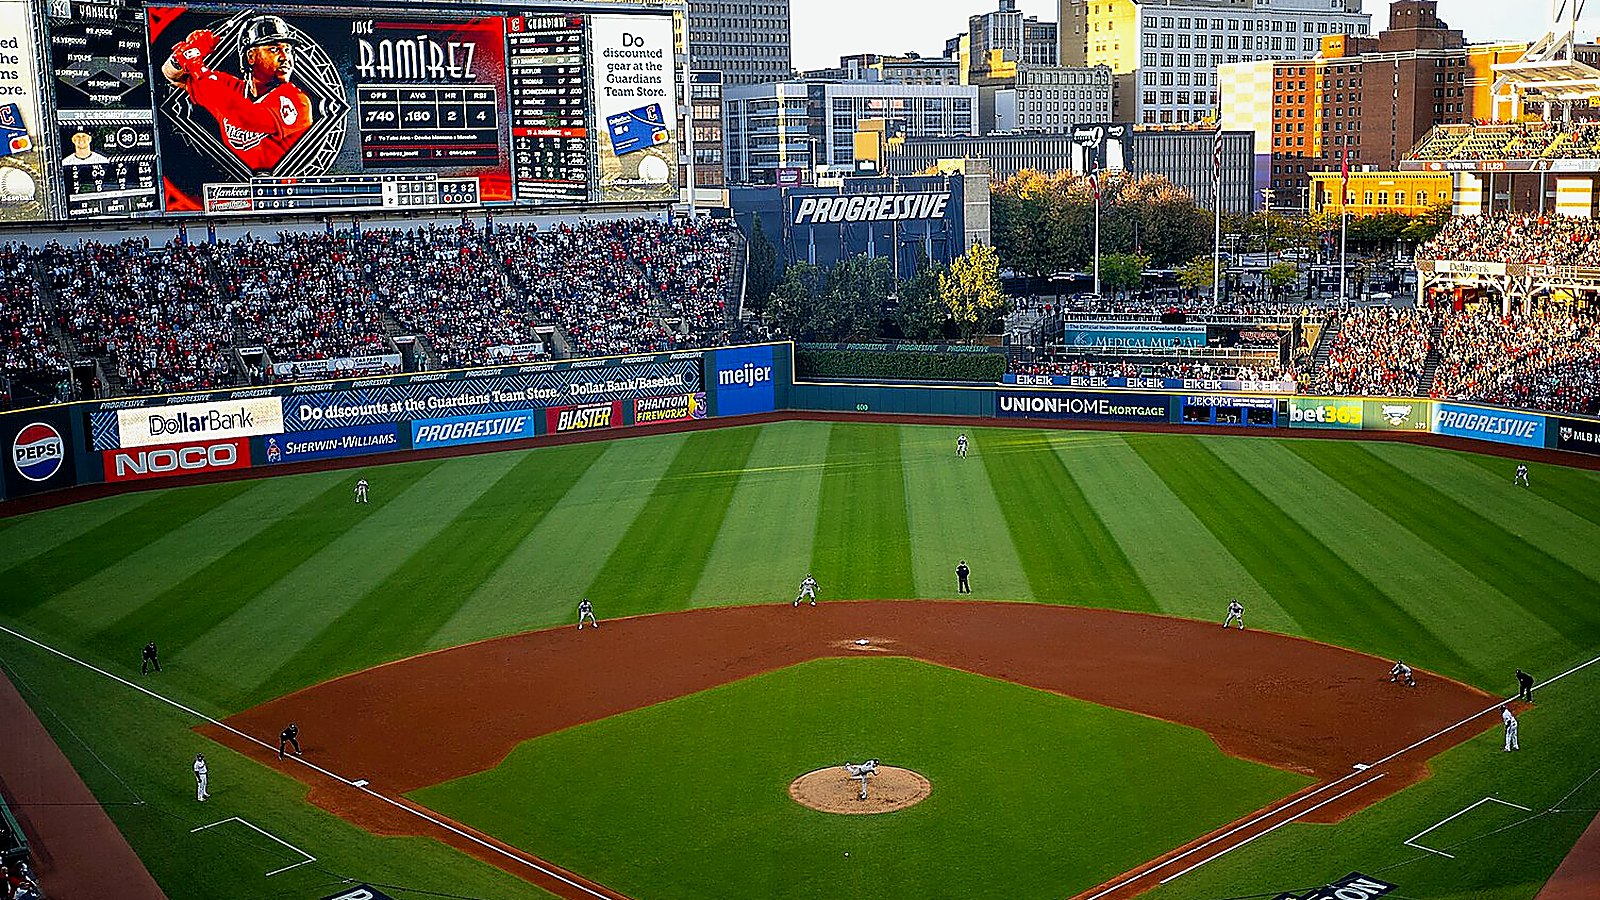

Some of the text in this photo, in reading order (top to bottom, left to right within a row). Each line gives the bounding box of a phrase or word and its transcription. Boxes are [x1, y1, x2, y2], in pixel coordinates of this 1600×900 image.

[79, 5, 118, 20] YANKEES
[528, 17, 566, 29] GUARDIANS
[0, 37, 18, 48] ed
[623, 33, 644, 47] Do
[356, 34, 477, 78] RAMÍREZ
[603, 48, 662, 58] discounted
[607, 63, 631, 72] gear
[645, 61, 662, 70] the
[607, 74, 662, 83] Guardians
[0, 86, 26, 95] ore.
[604, 87, 666, 96] Team Store.
[365, 111, 395, 122] .740
[448, 111, 457, 121] 2
[476, 111, 486, 120] 4
[211, 187, 249, 199] Yankees
[796, 194, 950, 224] PROGRESSIVE
[1096, 337, 1147, 347] MEDICAL
[718, 363, 770, 387] meijer
[293, 384, 334, 393] PROGRESSIVE
[352, 379, 392, 388] PROGRESSIVE
[167, 394, 210, 404] PROGRESSIVE
[231, 389, 274, 398] PROGRESSIVE
[100, 400, 145, 409] PROGRESSIVE
[300, 387, 560, 421] Do discounts at the Guardians Team Store.
[637, 396, 688, 410] PHANTOM
[637, 408, 688, 422] FIREWORKS
[1110, 405, 1164, 417] MORTGAGE
[1290, 404, 1362, 424] bet365
[149, 407, 252, 436] DollarBank
[558, 406, 612, 431] BLASTER
[1436, 410, 1537, 438] PROGRESSIVE
[415, 416, 526, 443] PROGRESSIVE
[1574, 431, 1592, 442] MLB
[16, 442, 61, 462] PEPSI
[116, 444, 237, 477] NOCO
